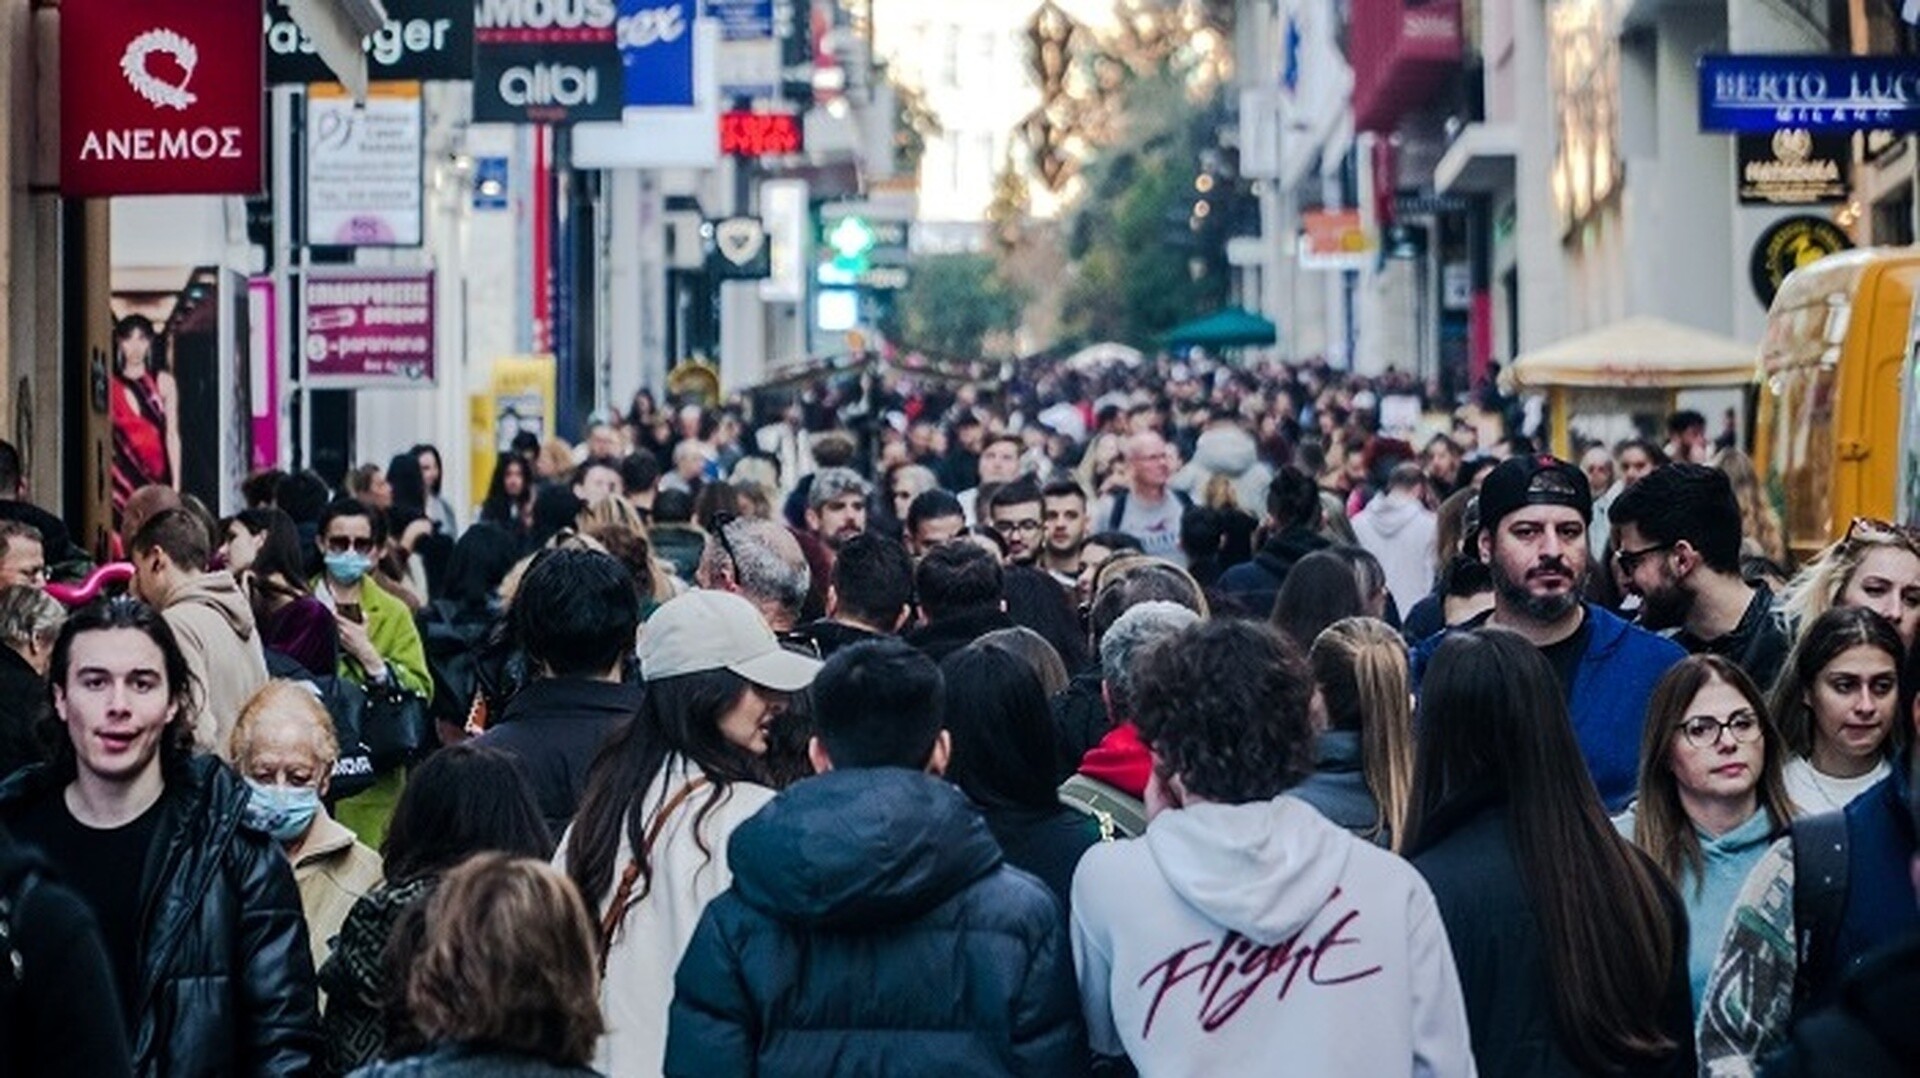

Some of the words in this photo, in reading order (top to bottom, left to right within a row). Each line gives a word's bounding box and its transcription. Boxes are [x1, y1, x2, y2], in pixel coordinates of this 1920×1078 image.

[1715, 71, 1828, 101] BERTO
[79, 126, 242, 160] ΑΝΕΜΟΣ
[1138, 886, 1383, 1040] Flight
